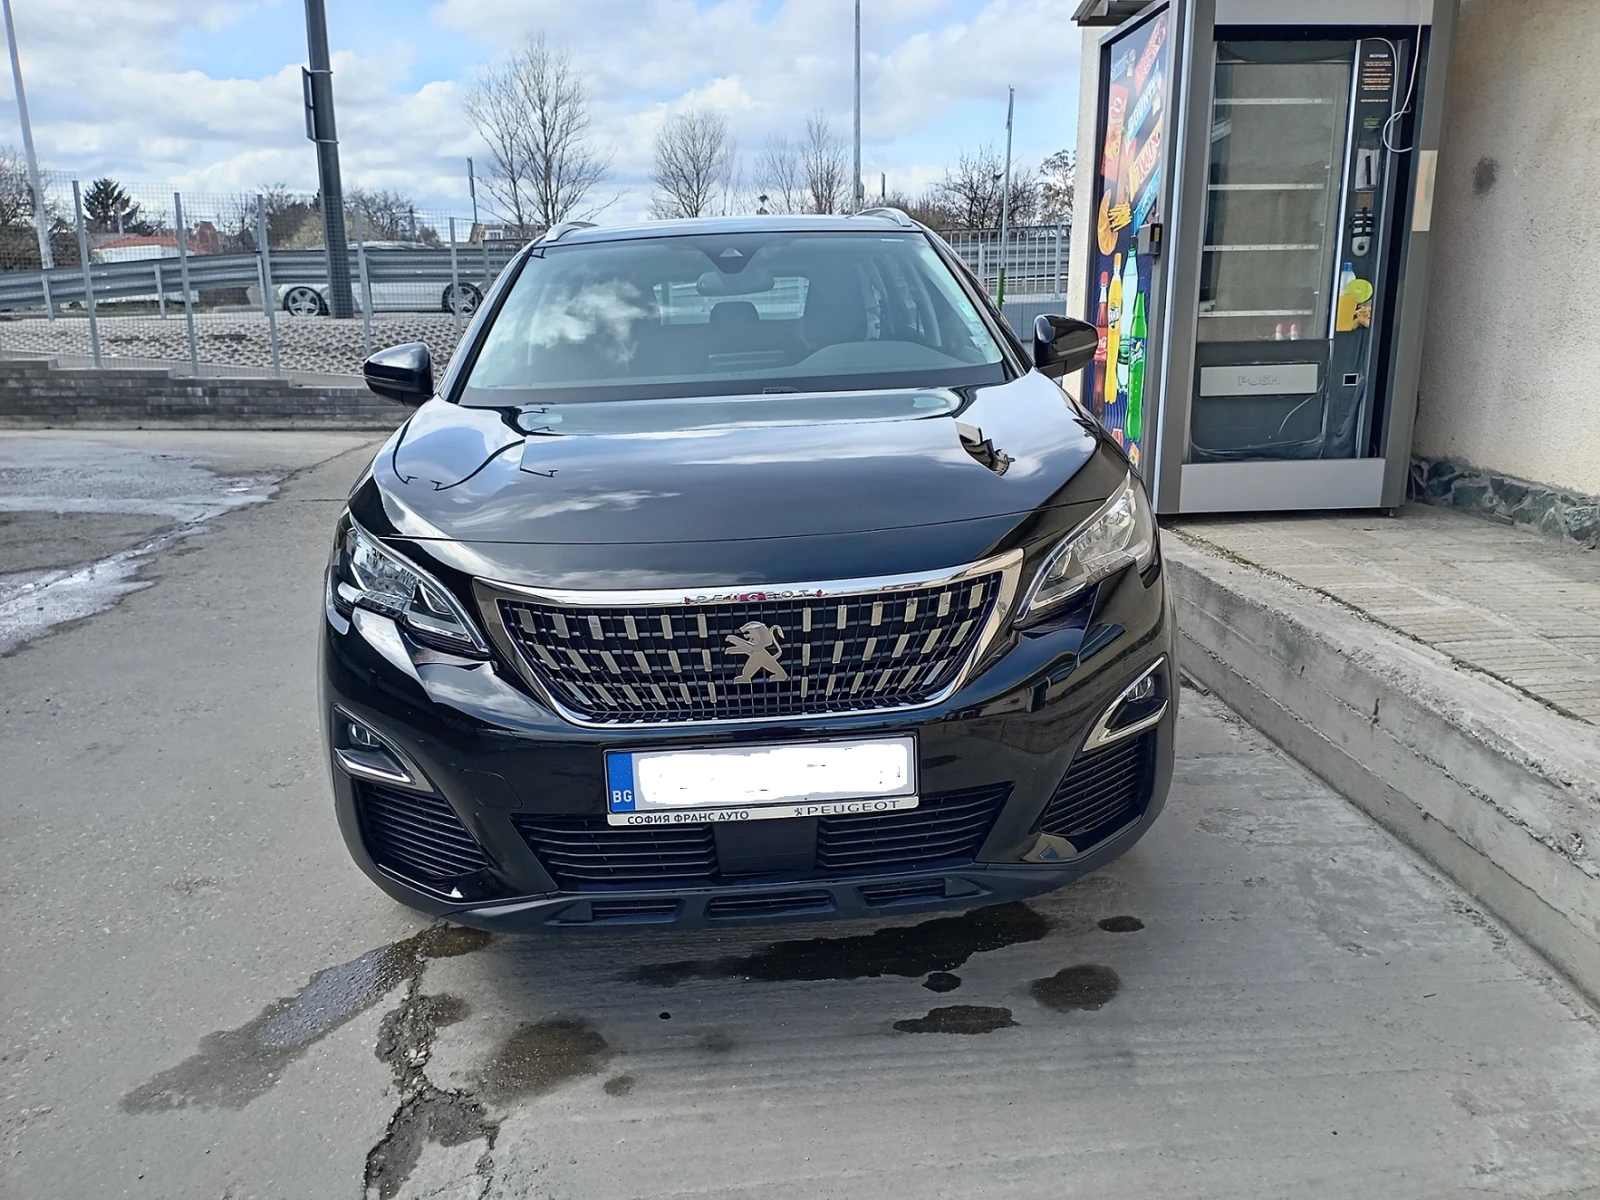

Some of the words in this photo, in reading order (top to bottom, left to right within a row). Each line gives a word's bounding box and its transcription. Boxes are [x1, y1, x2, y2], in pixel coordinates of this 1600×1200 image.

[1128, 74, 1161, 134] BOUNTY
[1135, 131, 1161, 184] TWIX
[1237, 374, 1281, 386] PUSH
[695, 589, 809, 603] PEUGEOT
[612, 789, 633, 804] BG
[807, 800, 901, 816] PEUGEOT
[627, 814, 671, 826] СОФИЯ
[674, 812, 716, 824] ФРАНС
[718, 810, 749, 821] АУТО
